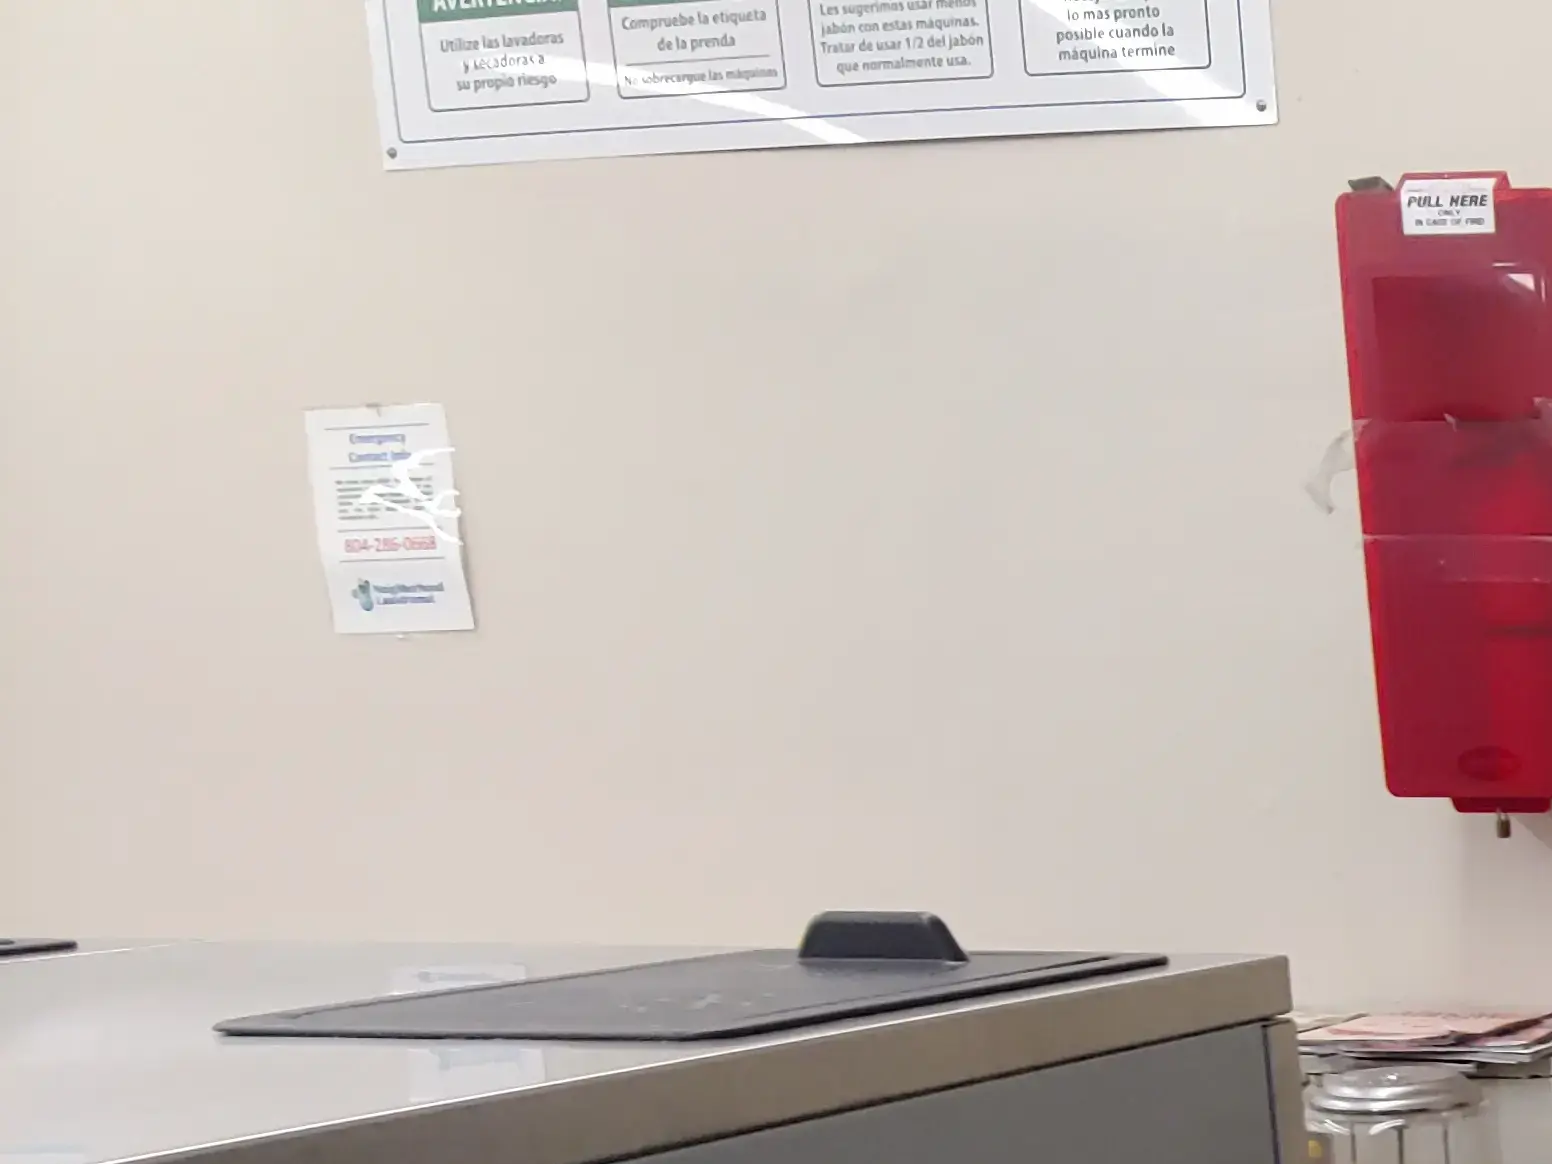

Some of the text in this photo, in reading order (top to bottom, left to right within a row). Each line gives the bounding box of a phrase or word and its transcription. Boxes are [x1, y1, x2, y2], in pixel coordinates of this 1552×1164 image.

[819, 0, 978, 17] Les sugerimos usar menos
[1067, 9, 1080, 21] lo
[1113, 6, 1160, 22] pronto
[621, 9, 767, 32] Compruebe la etiqueta
[820, 23, 856, 38] jabón
[858, 23, 880, 33] con
[882, 20, 913, 31] estas
[440, 32, 565, 53] Utilize las lavadoras
[657, 33, 736, 53] de la prenda
[1056, 21, 1175, 45] posible cuando la
[820, 33, 984, 54] Tratar de usar 1/2 del jabón
[1058, 43, 1176, 63] máquina termine
[463, 60, 470, 74] y
[538, 54, 545, 65] a
[836, 62, 859, 76] que
[862, 56, 943, 71] normalmente
[456, 73, 558, 94] su propio riesgo
[708, 69, 724, 81] las
[1407, 194, 1489, 208] PULL HERE
